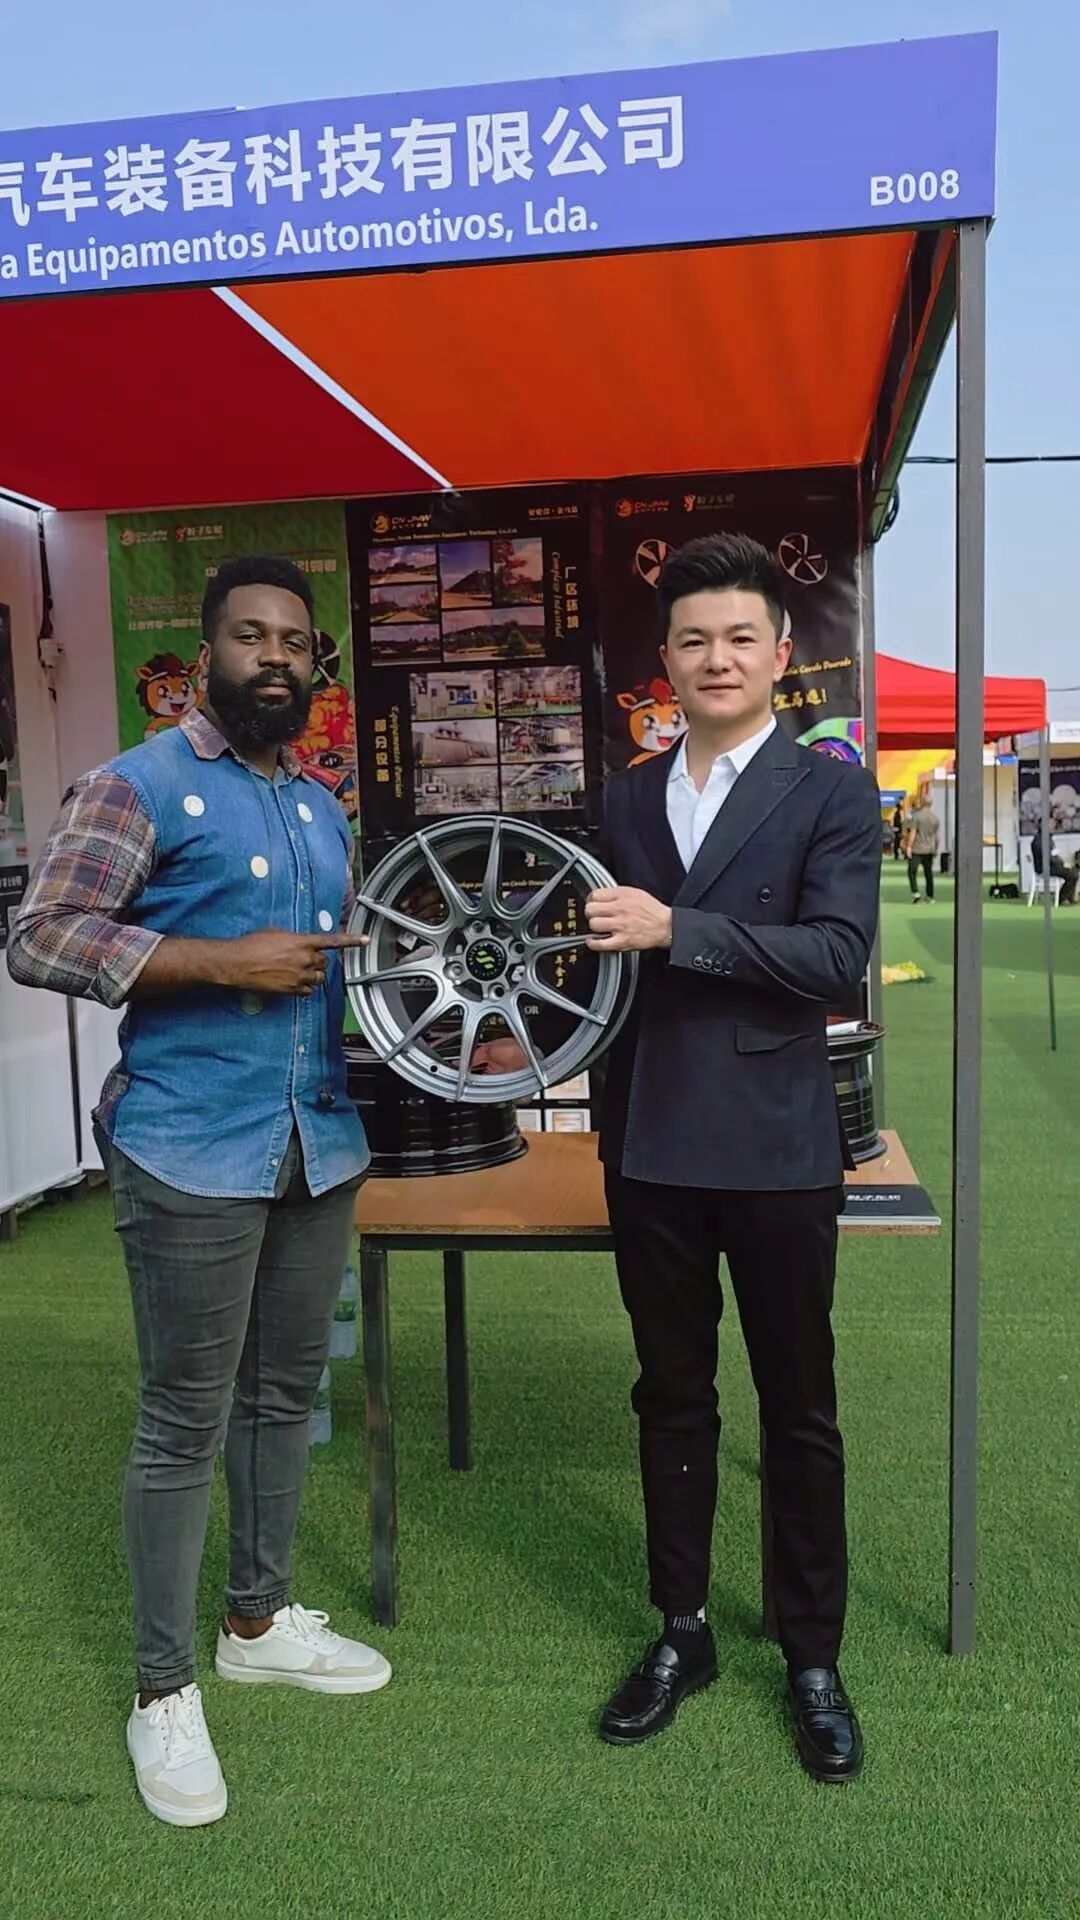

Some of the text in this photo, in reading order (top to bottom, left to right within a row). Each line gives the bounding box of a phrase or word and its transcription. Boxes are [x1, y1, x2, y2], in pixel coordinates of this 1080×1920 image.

[870, 169, 960, 206] B008
[27, 230, 267, 285] Equipamentos
[275, 207, 514, 256] Automotivos,
[525, 196, 598, 236] Lda.
